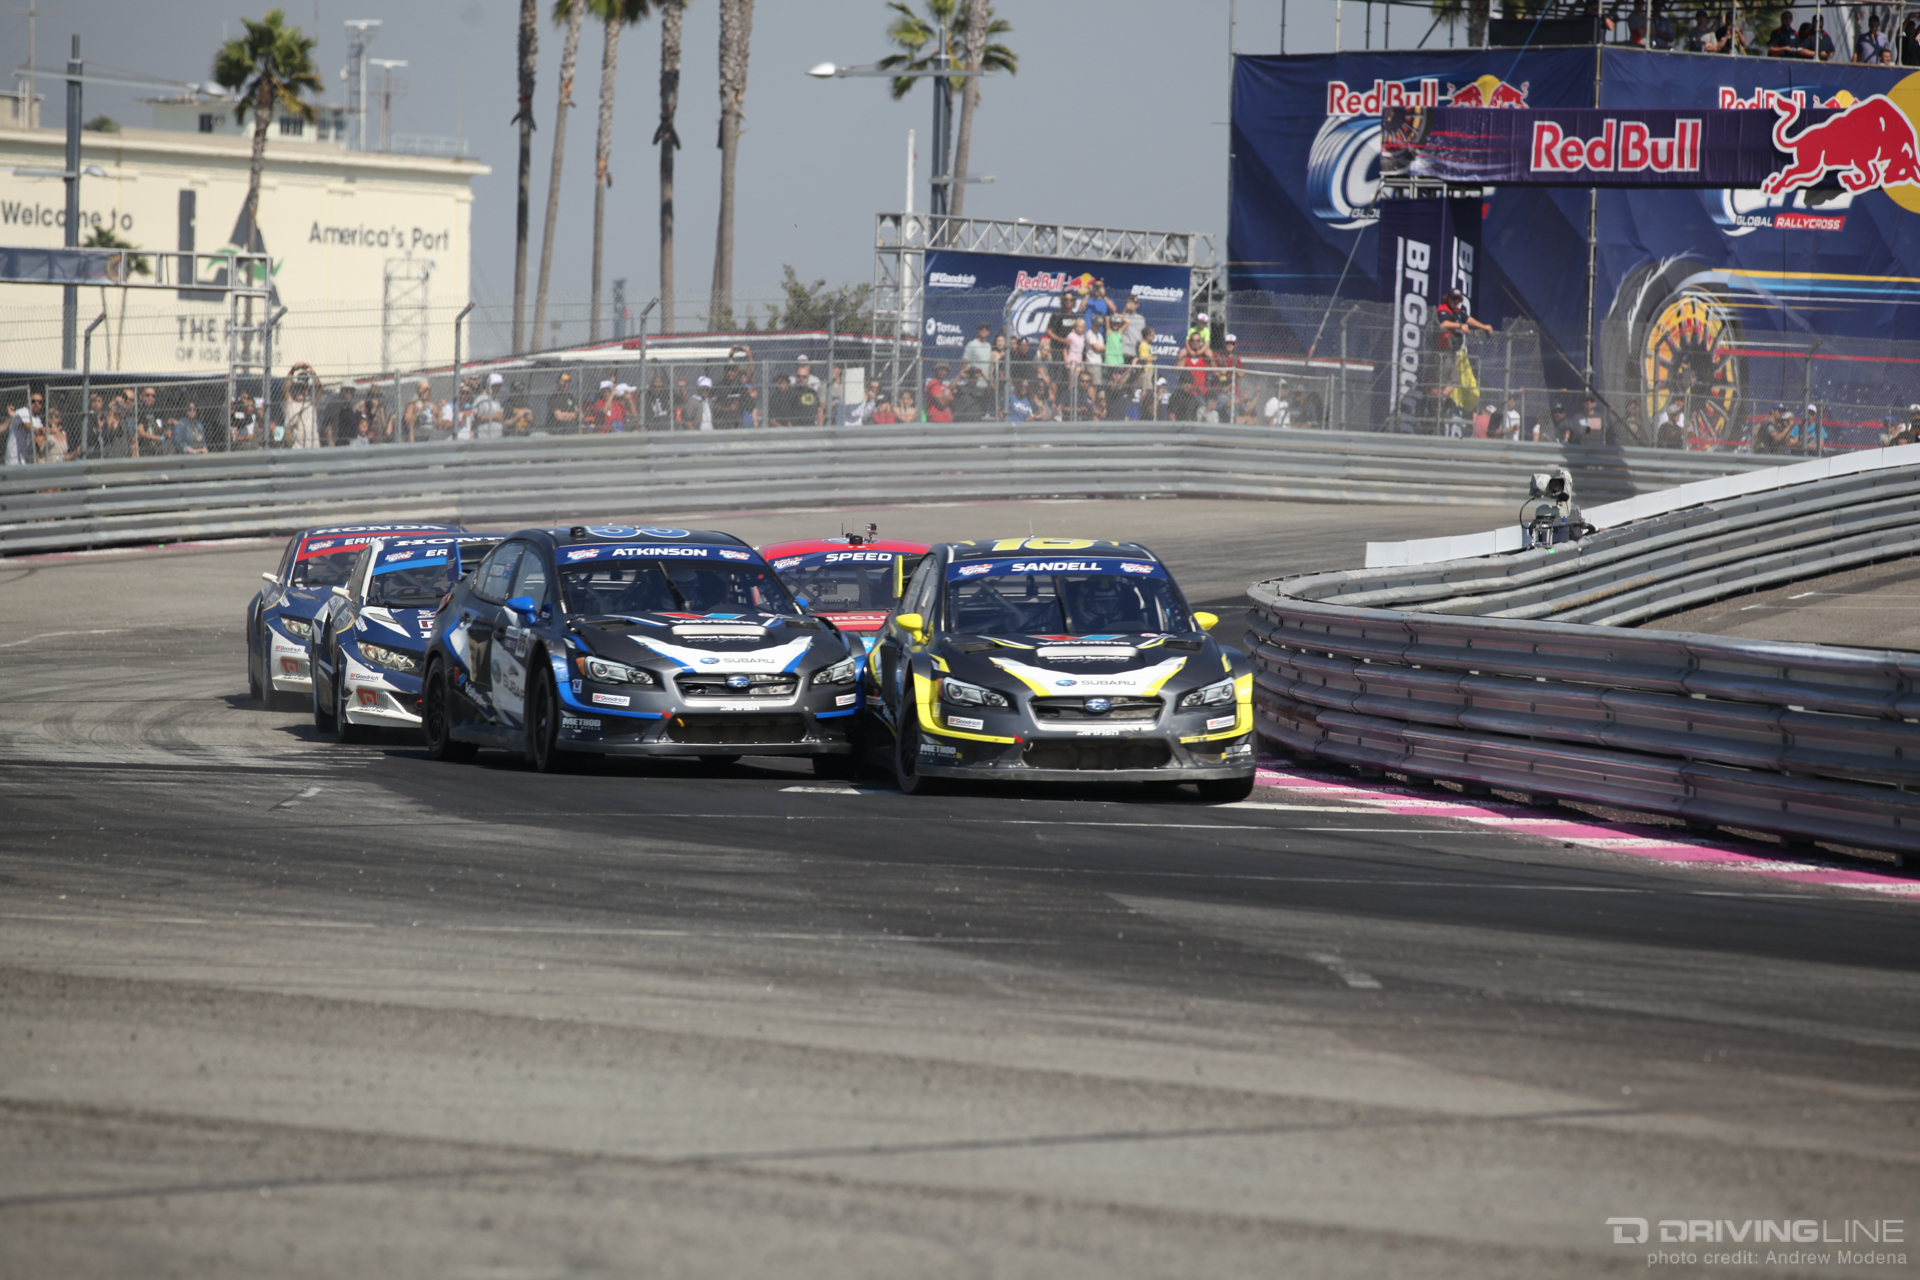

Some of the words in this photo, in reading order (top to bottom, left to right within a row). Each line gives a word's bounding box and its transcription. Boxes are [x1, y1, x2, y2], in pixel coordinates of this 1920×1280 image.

[1328, 80, 1382, 116] Red
[1531, 119, 1616, 172] Red
[1618, 119, 1702, 172] Bull
[1736, 215, 1773, 227] GLOBAL
[1776, 217, 1842, 230] RALLYCROSS
[309, 221, 405, 248] America's
[412, 228, 449, 251] Port
[1015, 270, 1043, 289] Red
[1040, 271, 1066, 291] Bull
[1131, 285, 1184, 298] BFGoodrich
[176, 316, 217, 342] THE
[936, 335, 965, 346] QUARTZ
[313, 525, 447, 535] HONDA
[612, 548, 708, 556] ATKINSON
[825, 553, 893, 562] SPEED
[1011, 562, 1102, 572] SANDELL
[594, 694, 628, 703] BFGoodrich
[562, 718, 601, 726] METHOD
[920, 744, 956, 754] METHOD
